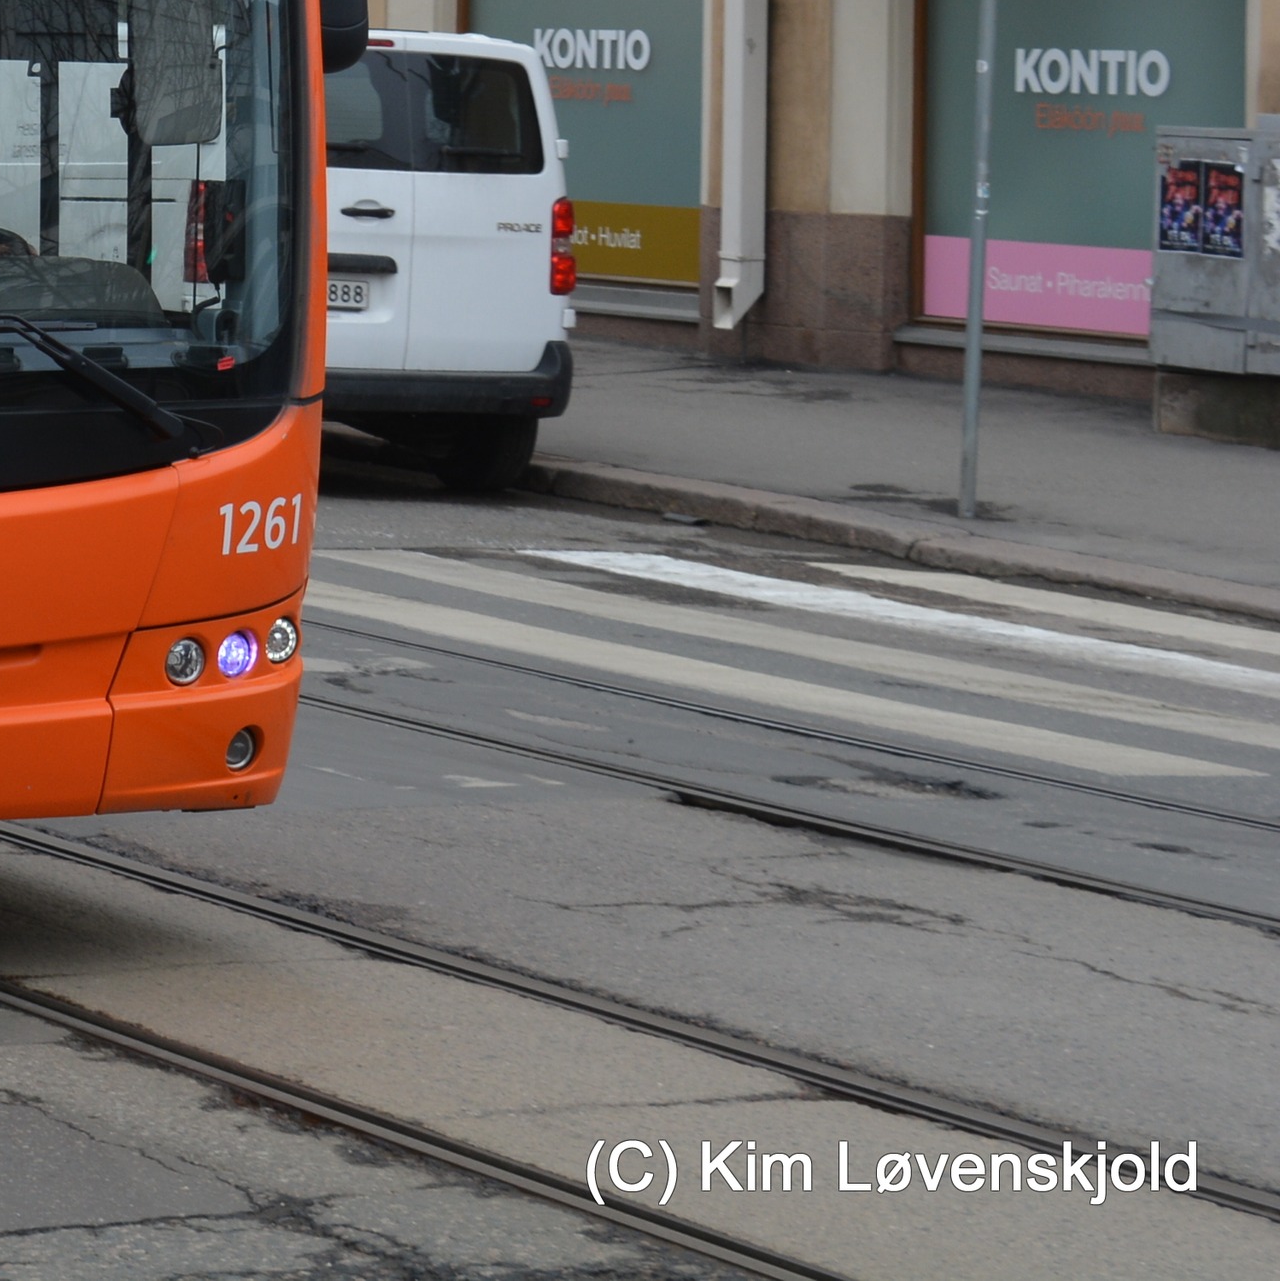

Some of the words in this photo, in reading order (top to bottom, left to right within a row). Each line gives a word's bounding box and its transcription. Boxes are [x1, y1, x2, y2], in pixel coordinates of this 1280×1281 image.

[534, 28, 651, 71] KONTIO
[1014, 47, 1171, 97] KONTIO
[598, 227, 642, 249] Huvilat
[328, 283, 364, 304] 888
[988, 266, 1043, 293] Saunat
[219, 493, 302, 556] 1261
